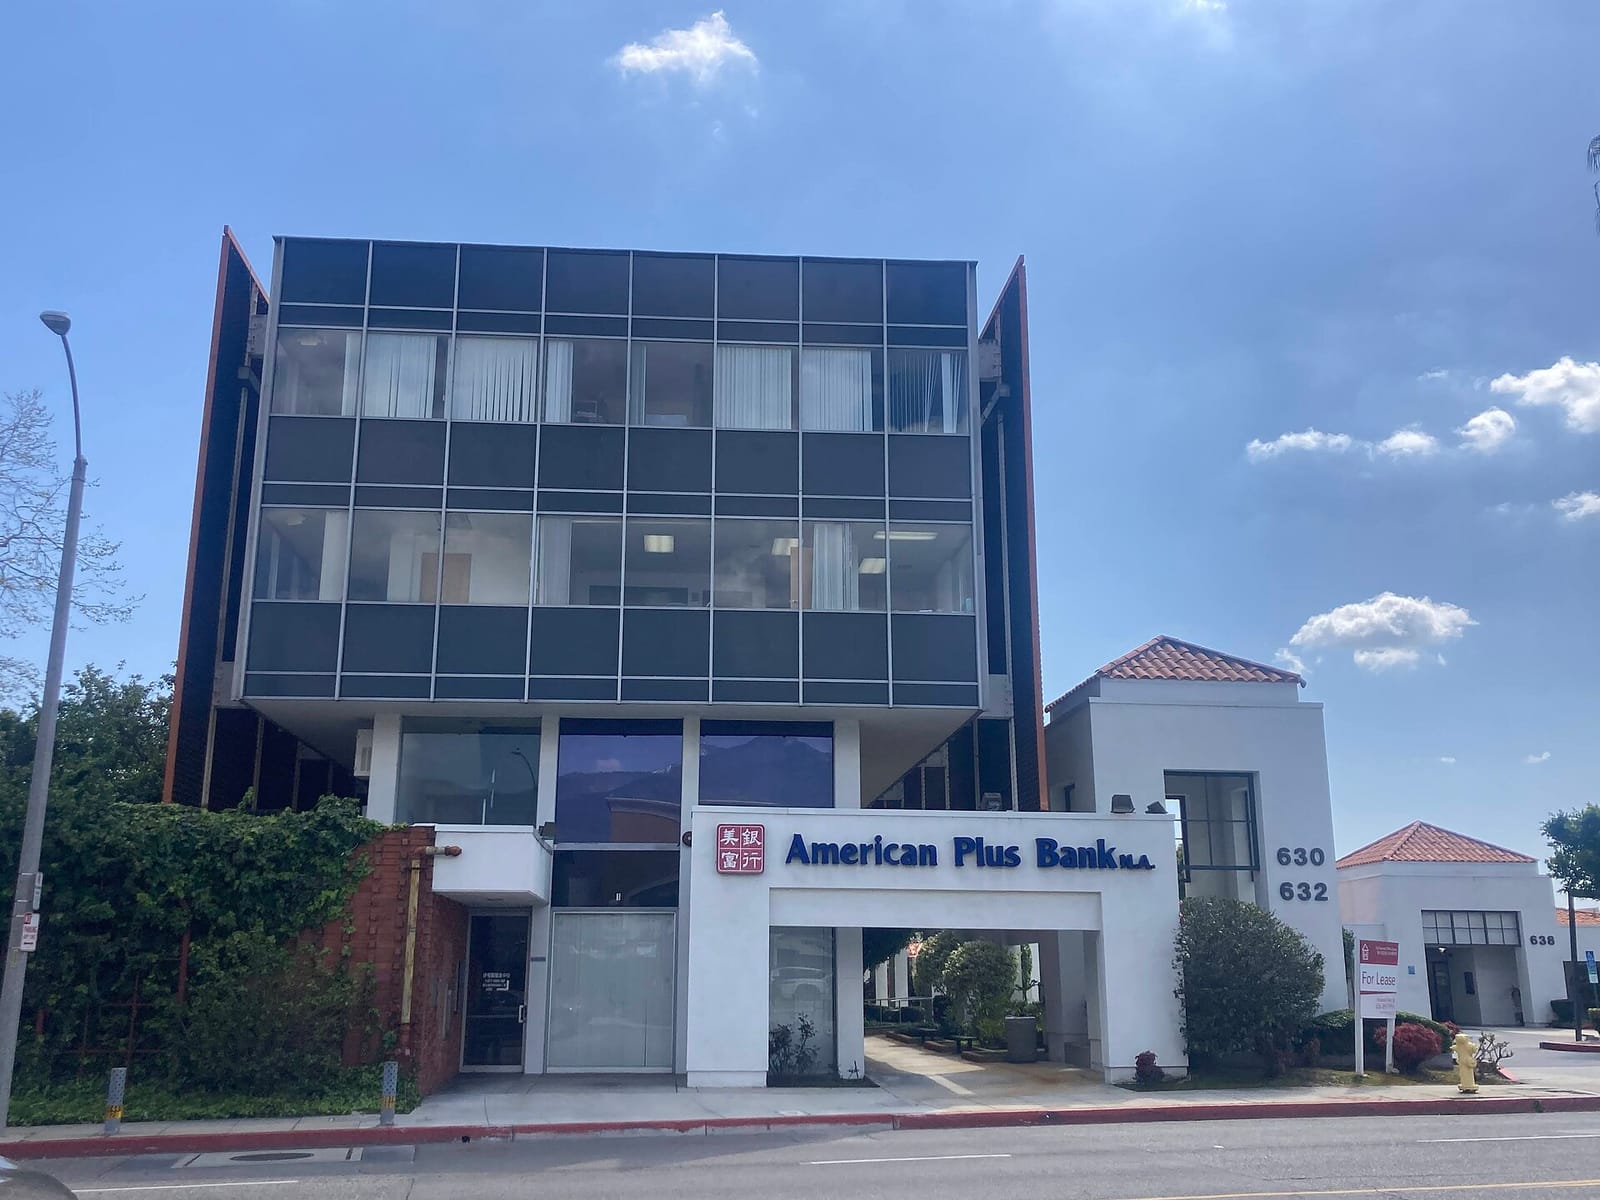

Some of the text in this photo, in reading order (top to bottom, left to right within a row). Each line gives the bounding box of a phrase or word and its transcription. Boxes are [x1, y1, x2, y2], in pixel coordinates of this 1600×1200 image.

[785, 833, 938, 867] American
[953, 836, 1021, 868] Plus
[1035, 837, 1118, 869] Bank
[1277, 847, 1325, 866] 630
[1280, 881, 1329, 902] 632
[1530, 935, 1555, 946] 638
[1362, 971, 1396, 986] For Lease
